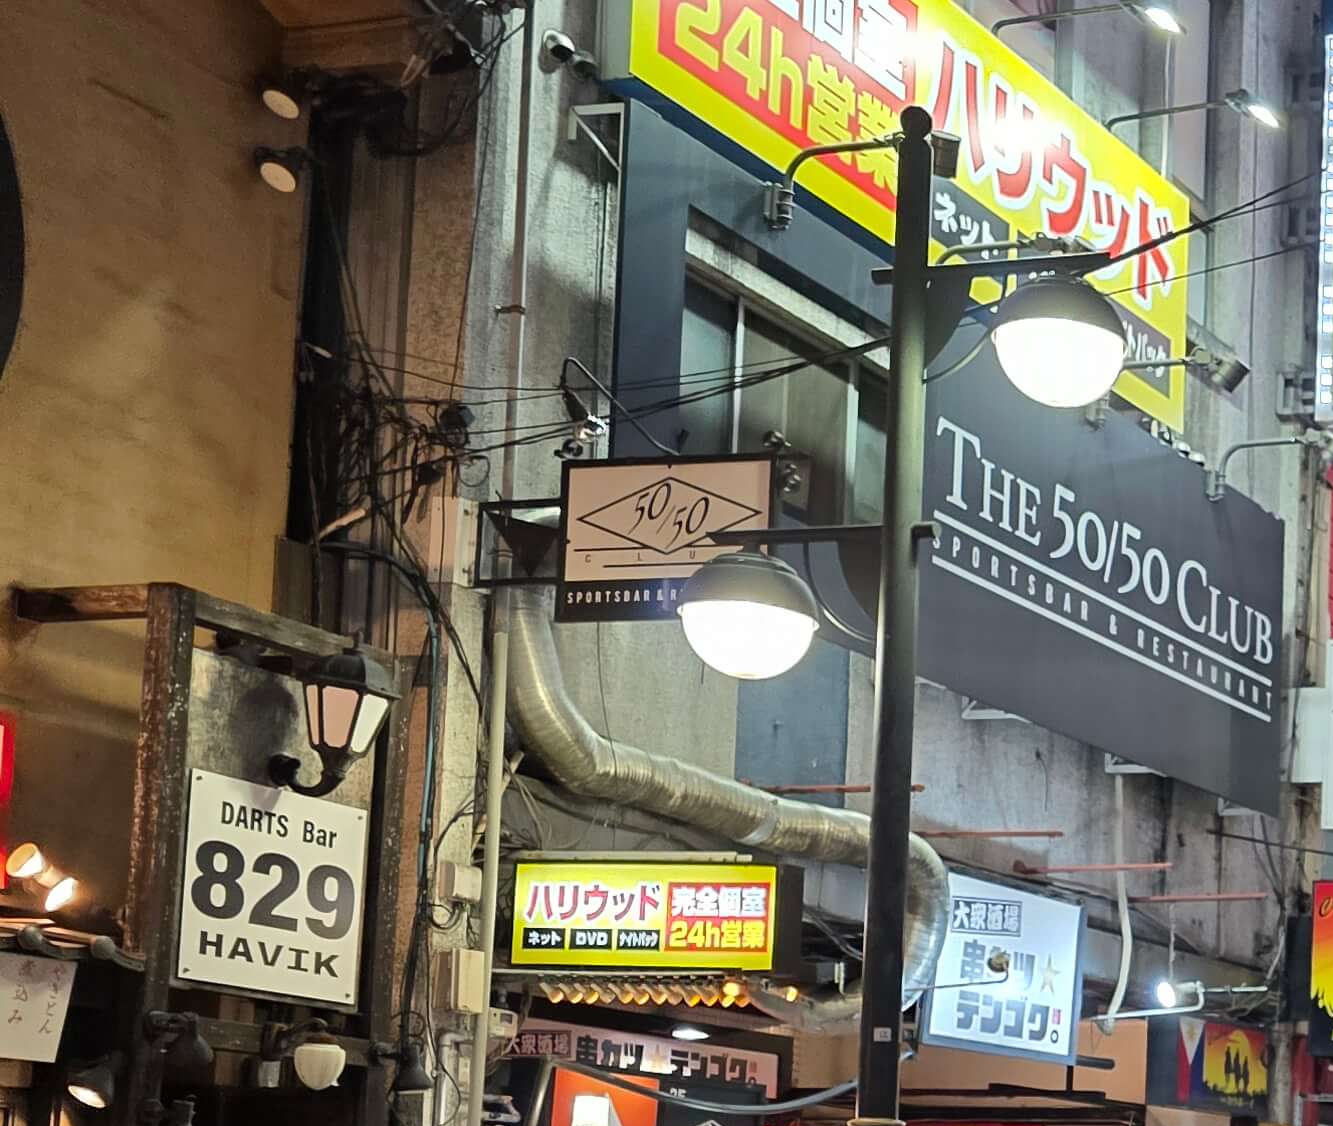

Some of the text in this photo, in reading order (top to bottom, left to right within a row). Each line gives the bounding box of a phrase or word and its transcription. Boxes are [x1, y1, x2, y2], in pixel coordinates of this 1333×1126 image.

[930, 38, 1176, 312] ハリウッド
[627, 482, 711, 550] 50/50
[936, 416, 1274, 666] THE 50/50 CLUB
[567, 588, 651, 605] SPORTSBAR
[932, 531, 1274, 711] SPORTSBAR & RESTAURANT
[220, 801, 338, 850] DARTS Bar
[191, 839, 356, 942] 829
[525, 884, 662, 922] ハリウッド
[671, 886, 767, 918] 完全個室
[574, 931, 609, 945] DVD
[669, 920, 767, 949] 24h営業
[953, 900, 1020, 933] 大衆酒場
[198, 930, 340, 979] HAVIK
[527, 931, 563, 946] ネット
